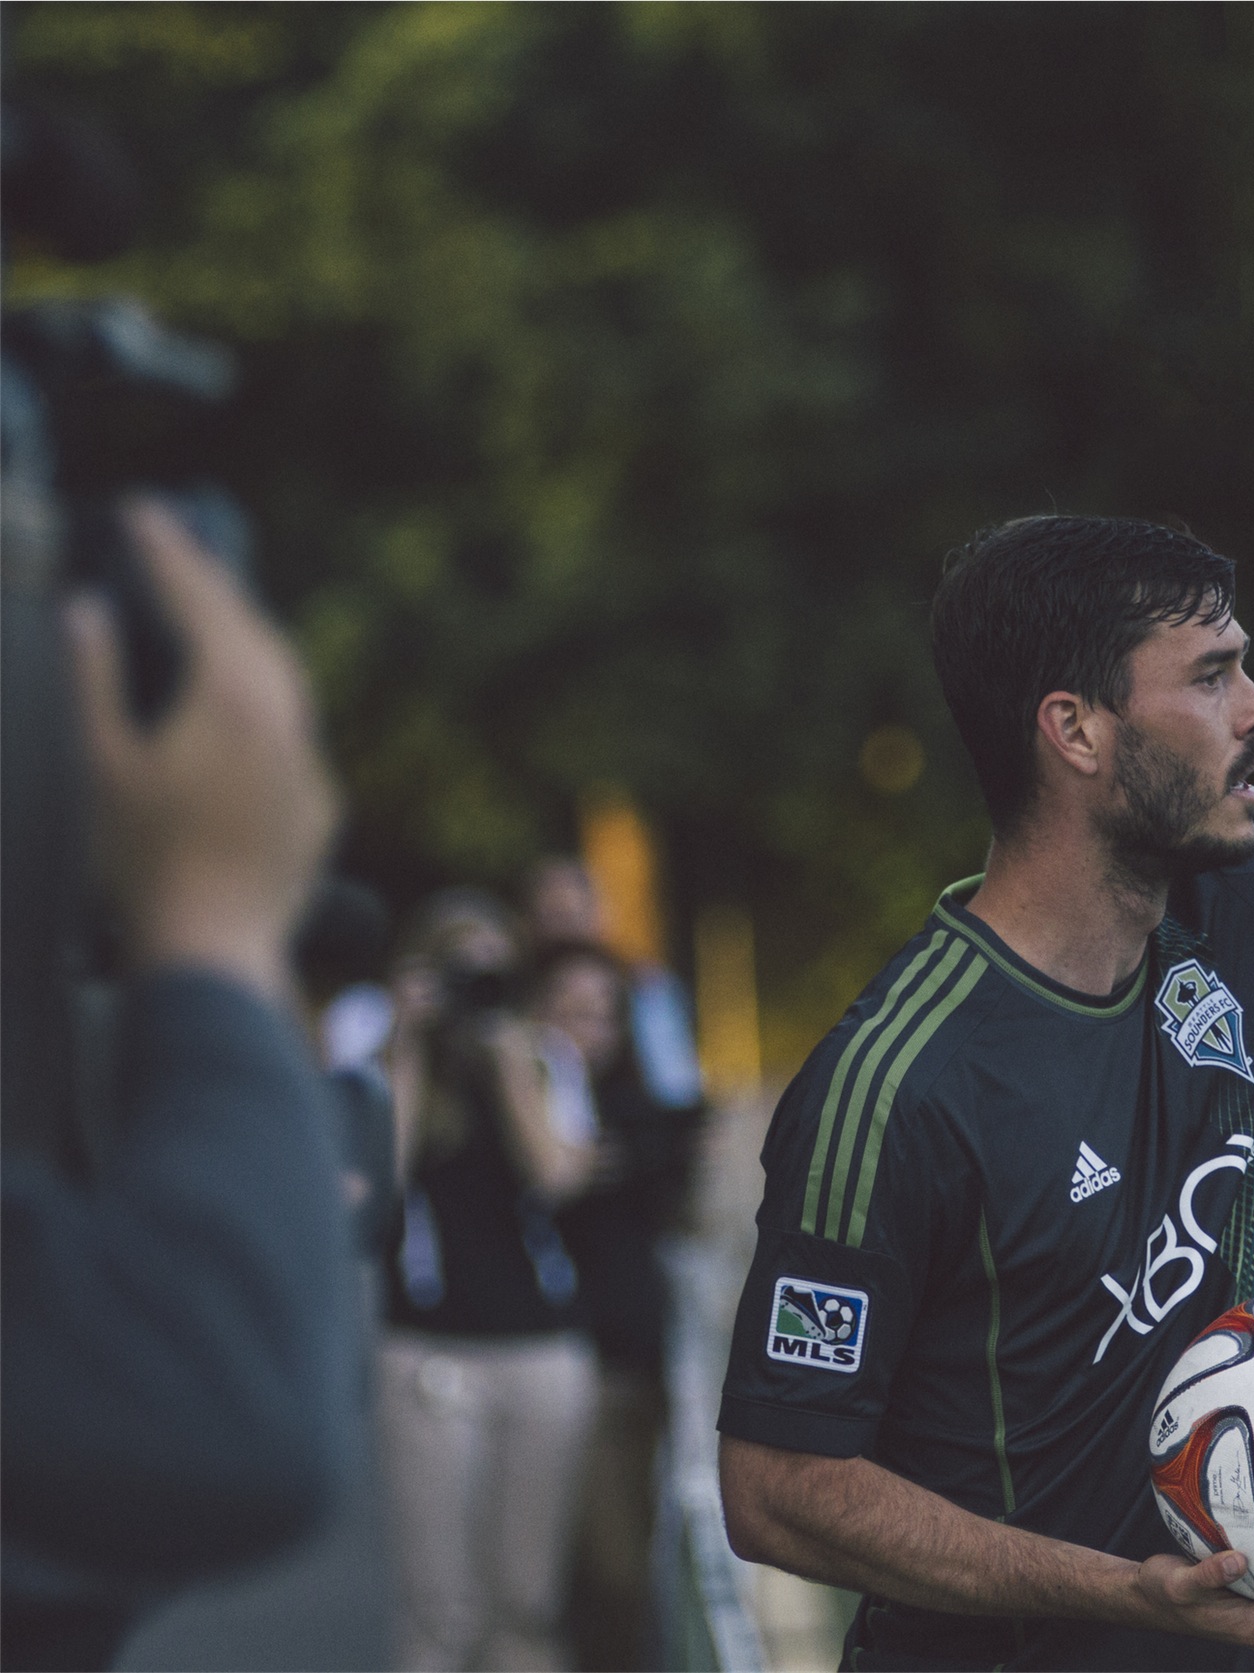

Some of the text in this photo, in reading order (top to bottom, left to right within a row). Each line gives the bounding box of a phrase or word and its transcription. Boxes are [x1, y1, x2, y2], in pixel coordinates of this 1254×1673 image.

[1184, 997, 1232, 1051] SOUNDERS FC
[1070, 1167, 1121, 1203] adidas
[1093, 1133, 1254, 1366] XBO
[772, 1335, 855, 1365] MLS
[1156, 1421, 1179, 1447] adidas
